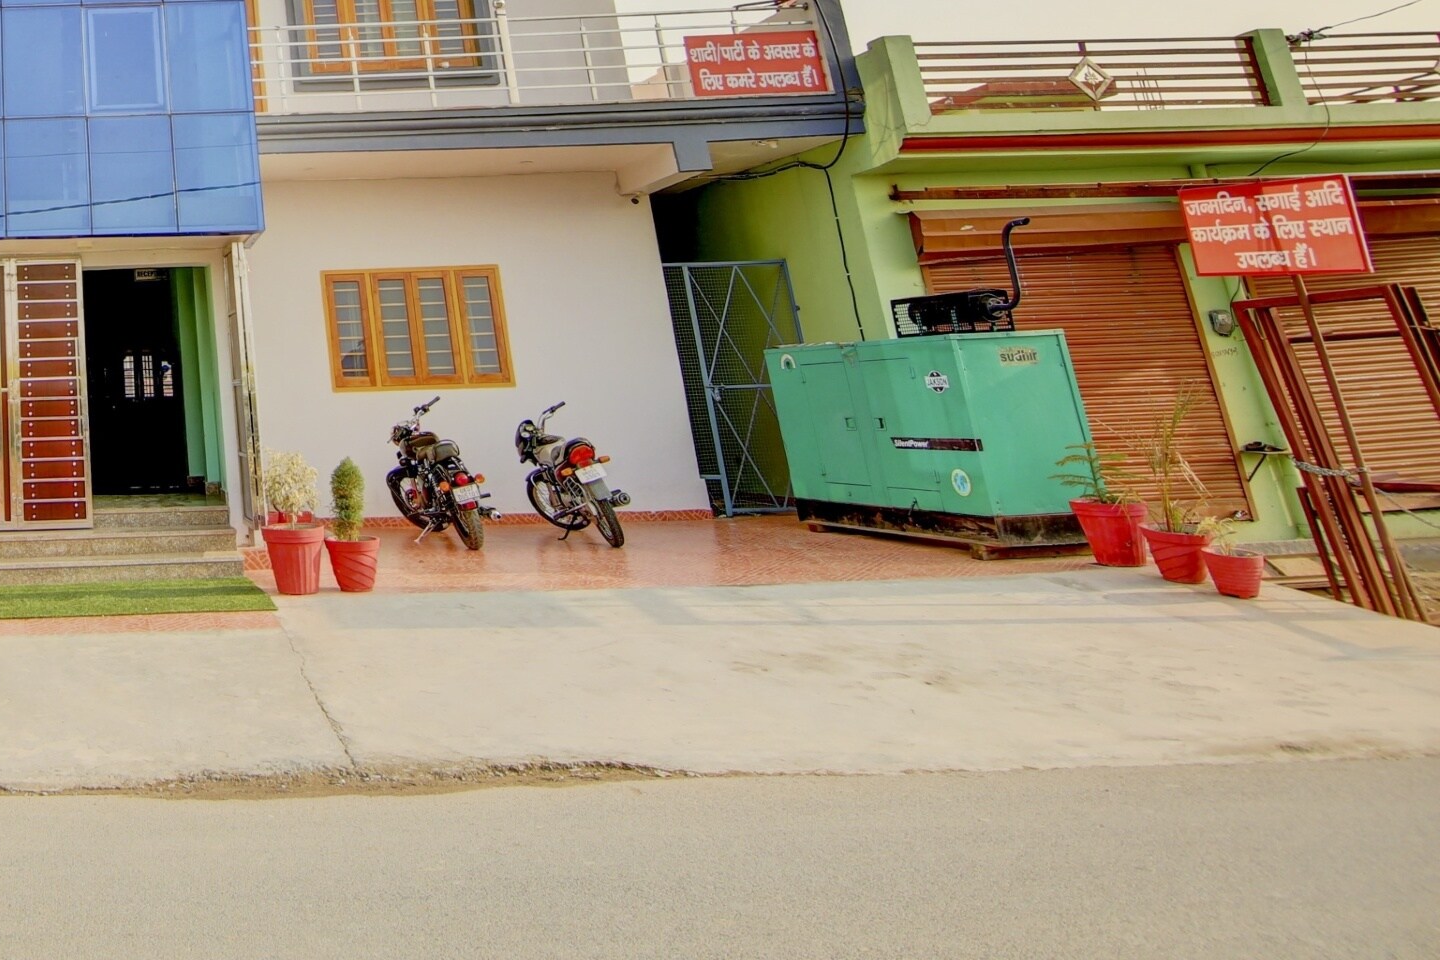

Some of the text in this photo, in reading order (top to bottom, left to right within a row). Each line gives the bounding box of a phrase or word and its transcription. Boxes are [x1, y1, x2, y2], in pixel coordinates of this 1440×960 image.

[689, 37, 815, 64] शादी/पार्टी के अवसर के
[699, 68, 724, 91] लिए
[724, 67, 757, 88] कमरे
[757, 71, 800, 88] उपलब्ध
[1183, 181, 1345, 216] जन्मदिन, सगाई आदि
[1190, 214, 1353, 244] कार्यक्रम के लिए स्थान
[1234, 250, 1291, 269] उपलब्ध
[926, 376, 948, 387] JAKSON
